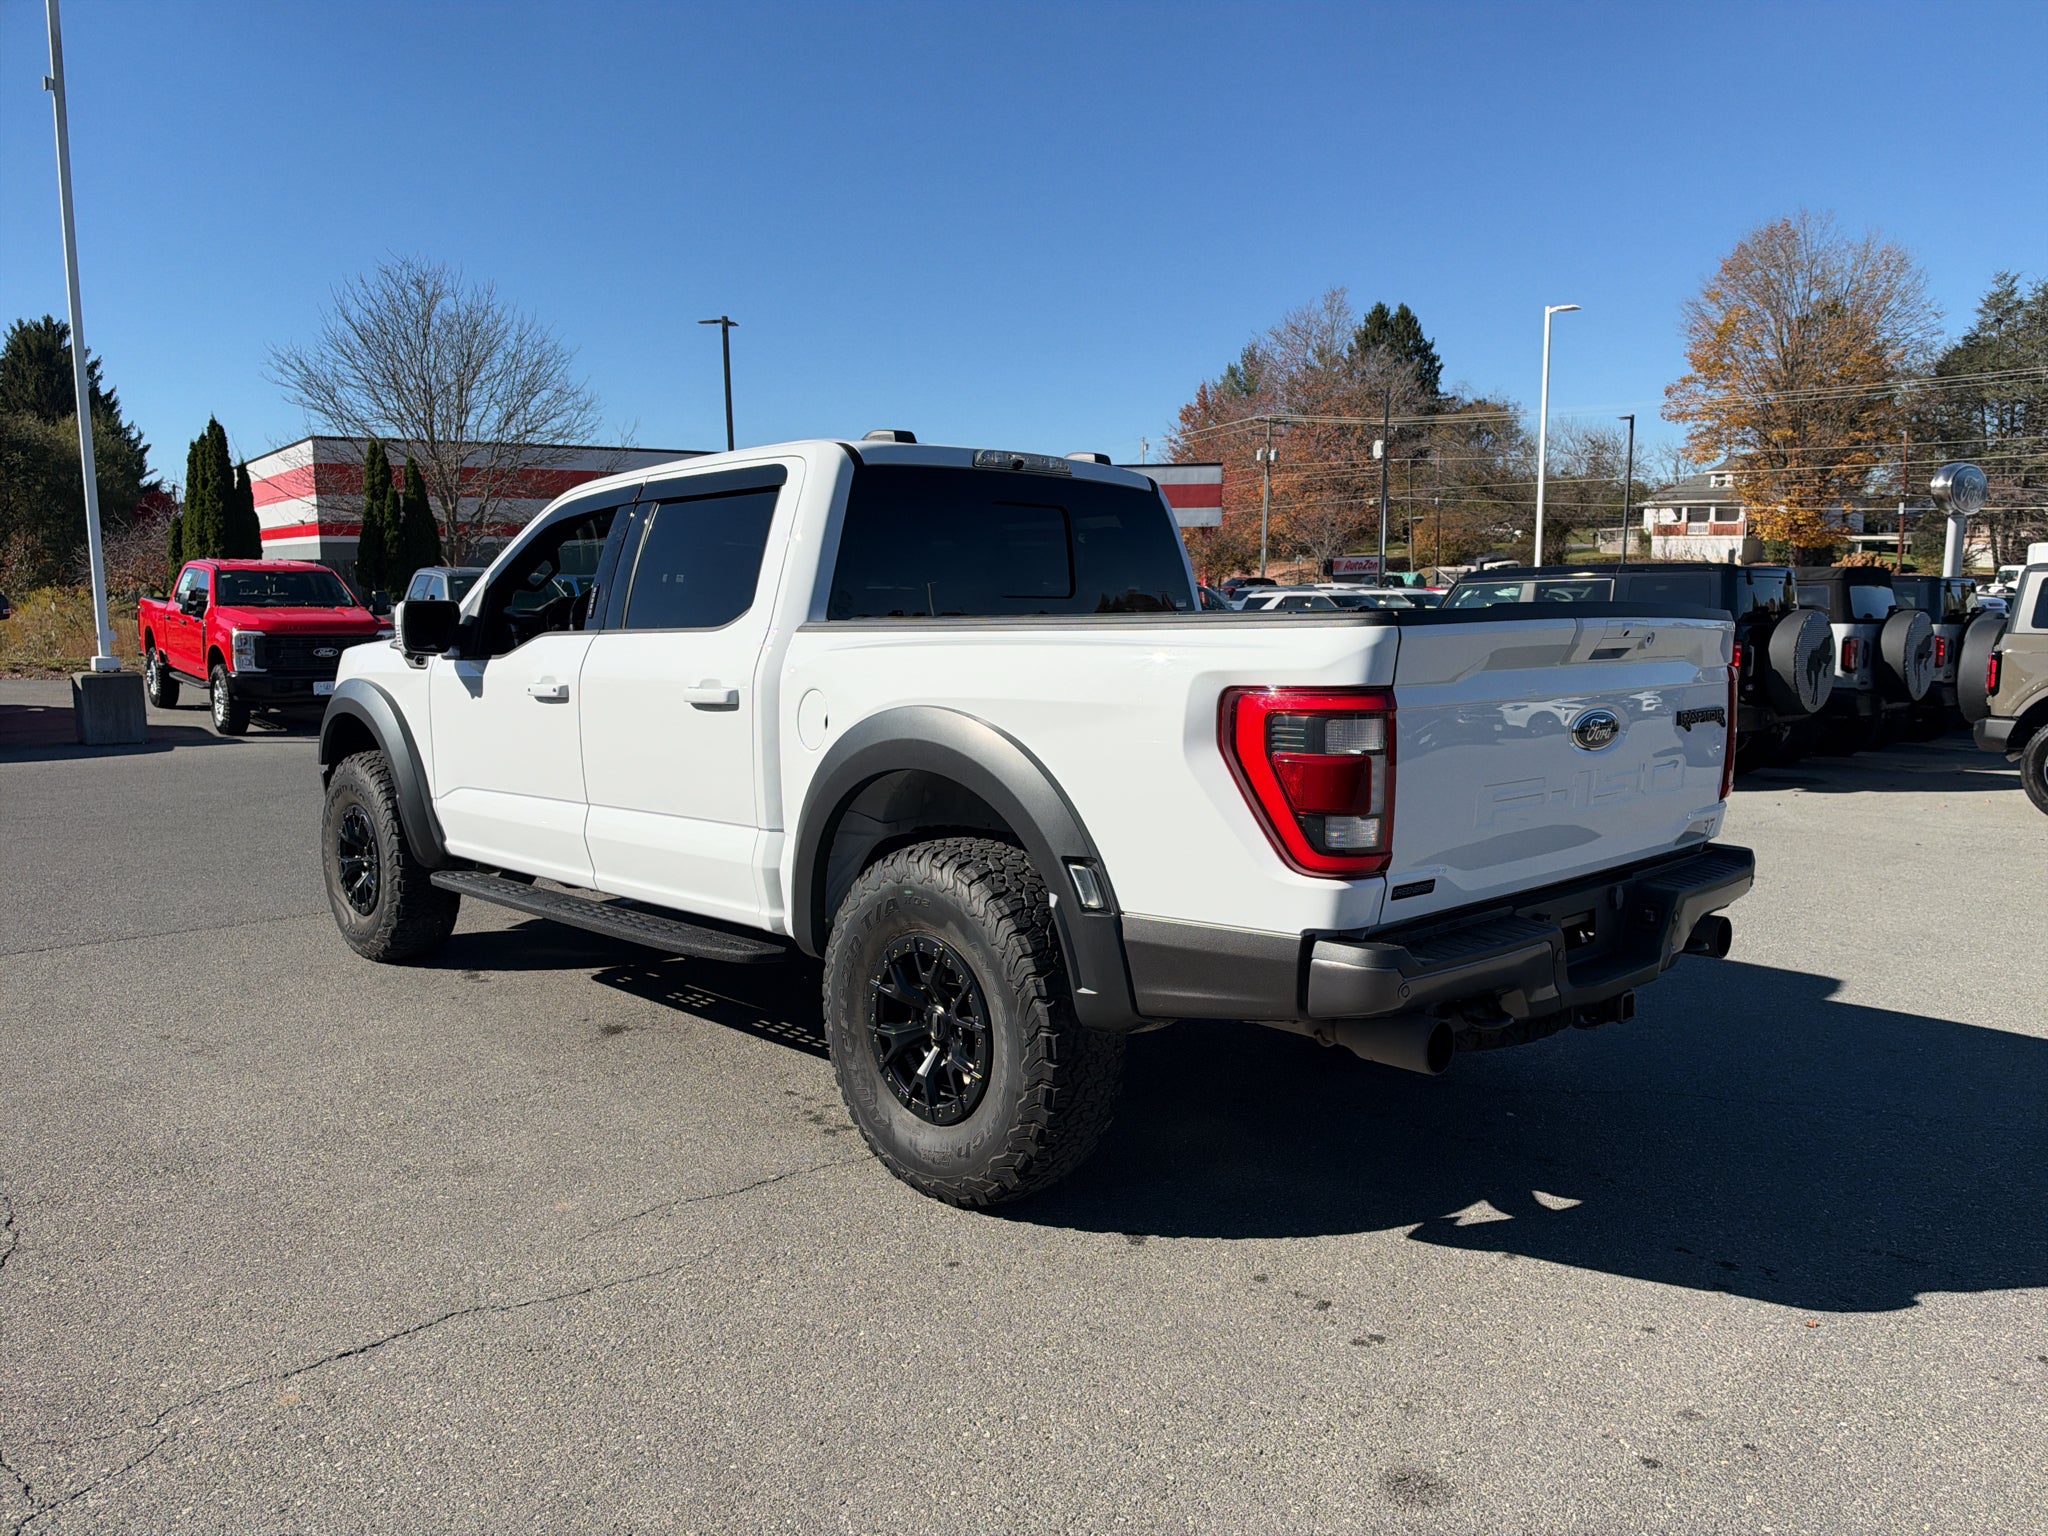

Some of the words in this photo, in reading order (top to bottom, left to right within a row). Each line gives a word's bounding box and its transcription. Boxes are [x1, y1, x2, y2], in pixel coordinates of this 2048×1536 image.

[1960, 475, 1983, 503] Ford
[1343, 559, 1379, 571] AutoZon
[1586, 718, 1613, 742] Ford
[1680, 706, 1726, 732] RAPTOR
[860, 897, 901, 933] T/A
